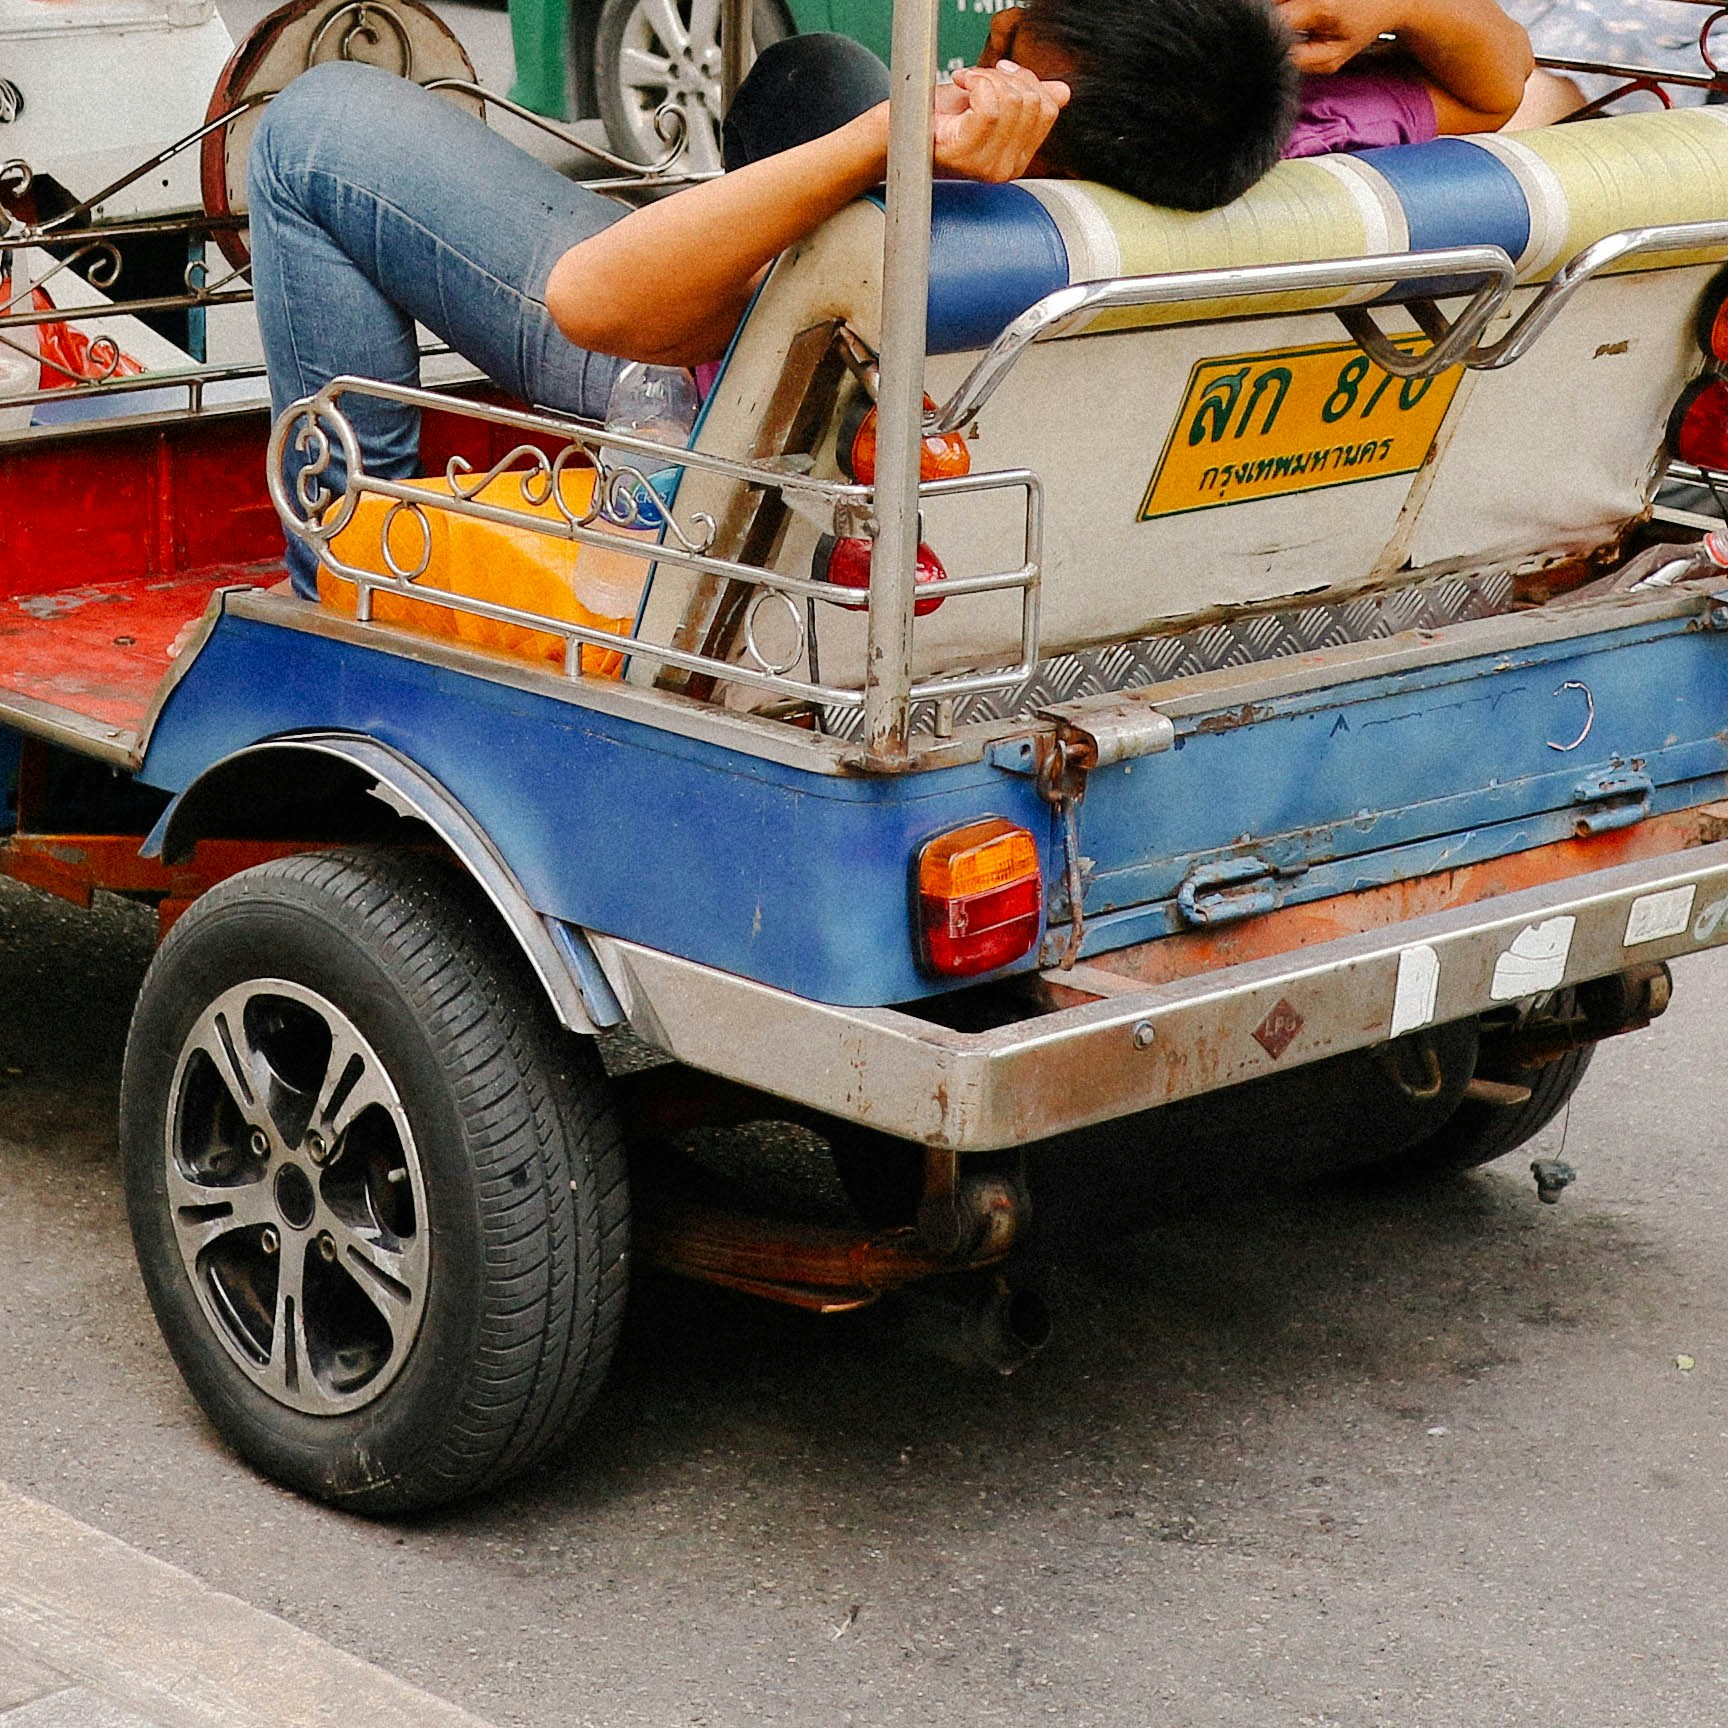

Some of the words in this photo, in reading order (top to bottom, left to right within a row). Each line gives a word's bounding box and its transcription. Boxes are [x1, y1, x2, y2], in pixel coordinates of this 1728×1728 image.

[1188, 365, 1293, 447] สก
[1198, 437, 1395, 497] กรุงเทพมหานคร
